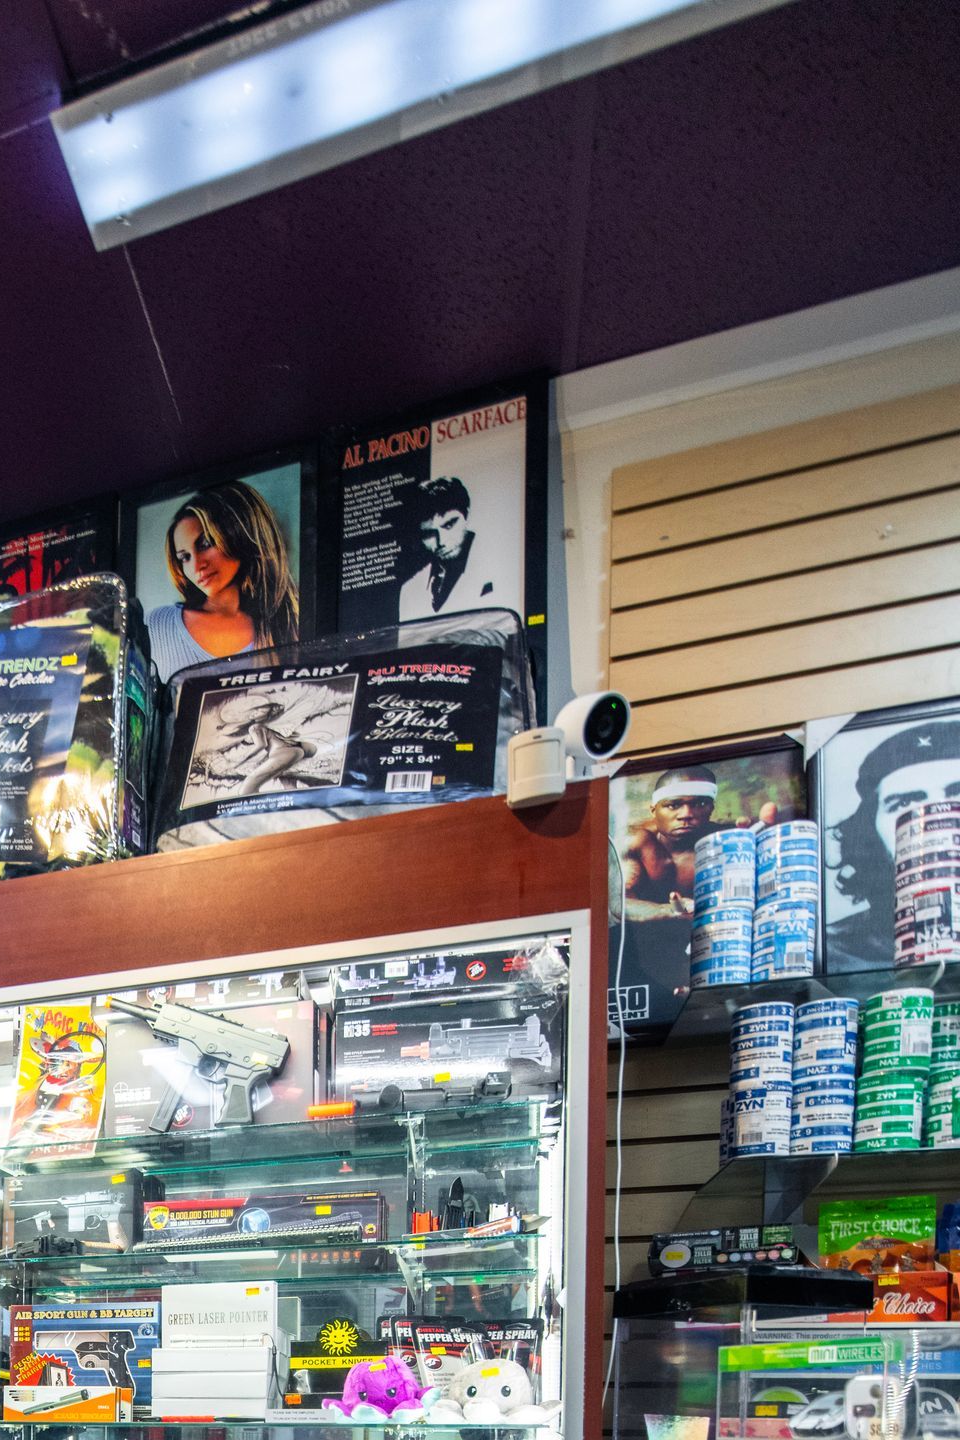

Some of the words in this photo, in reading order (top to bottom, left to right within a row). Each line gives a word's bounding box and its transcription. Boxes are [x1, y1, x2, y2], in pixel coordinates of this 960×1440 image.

[436, 399, 527, 444] SCARFACE
[342, 444, 364, 469] AL
[367, 426, 430, 463] PACINO
[219, 671, 271, 688] TREE
[282, 662, 350, 682] FAIRY
[367, 666, 395, 676] NU
[398, 664, 472, 676] TRENDZ
[367, 694, 463, 714] Luxury
[375, 708, 449, 730] Plush
[364, 728, 460, 743] Blankets
[391, 744, 424, 756] SIZE
[404, 756, 414, 764] x
[725, 851, 752, 865] ZYN
[776, 920, 808, 934] ZYN
[904, 1007, 932, 1020] ZYN
[735, 1099, 765, 1113] ZYN
[830, 1220, 870, 1241] FIRST
[872, 1218, 923, 1238] CHOICE
[883, 1291, 936, 1316] Choice
[15, 1311, 33, 1320] AIR
[33, 1310, 65, 1320] SPORT
[66, 1309, 88, 1320] GUN
[99, 1309, 113, 1319] BB
[113, 1308, 155, 1319] TARGET
[167, 1312, 195, 1326] GREEN
[198, 1311, 226, 1325] LASER
[228, 1310, 269, 1323] POINTER
[418, 1333, 453, 1343] PEPPER
[505, 1329, 538, 1340] SPRAY
[795, 1332, 810, 1340] This
